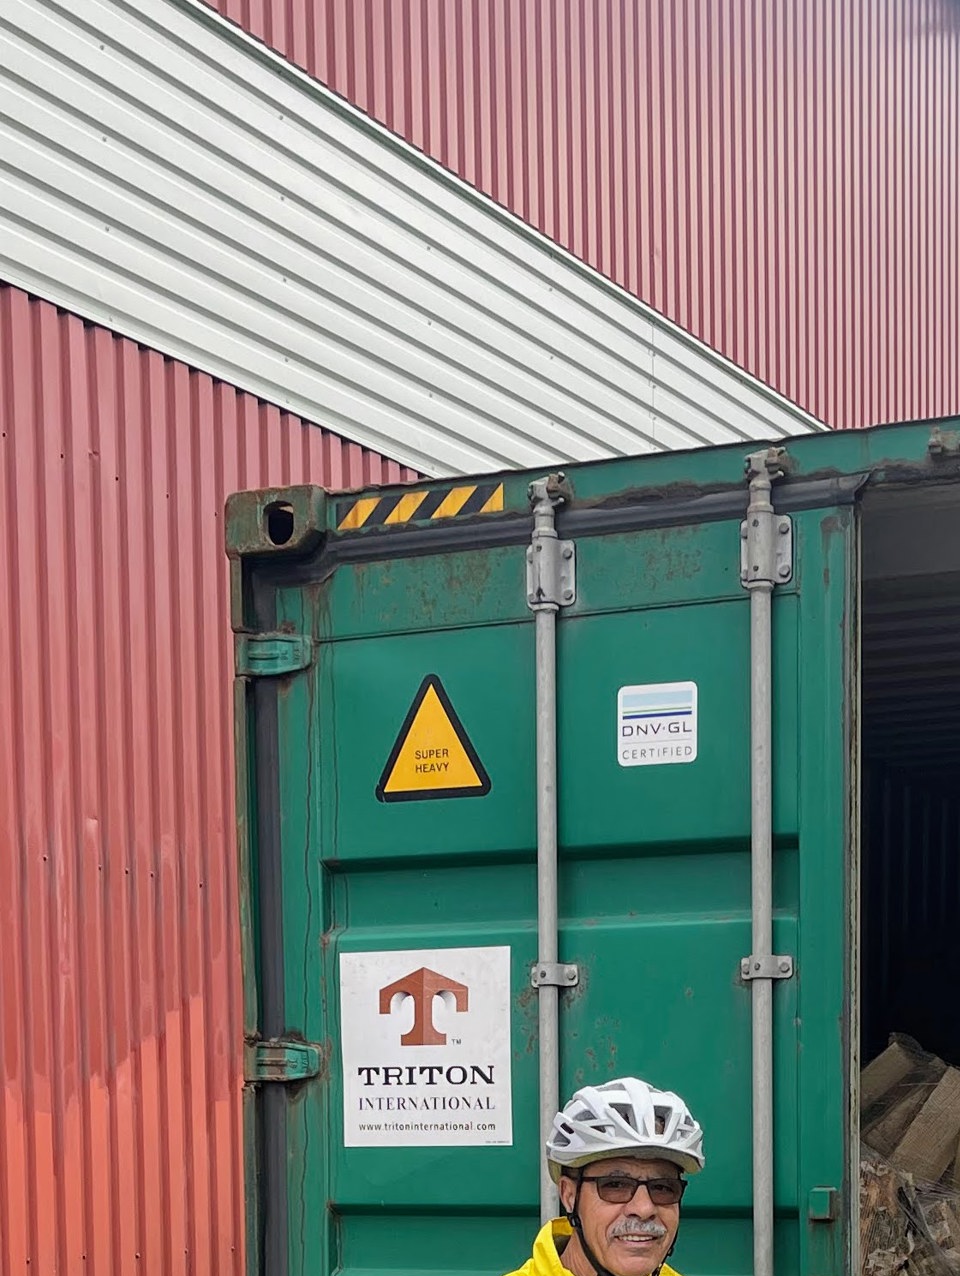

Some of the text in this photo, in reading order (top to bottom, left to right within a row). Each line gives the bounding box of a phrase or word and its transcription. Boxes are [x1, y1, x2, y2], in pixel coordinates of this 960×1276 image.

[414, 748, 449, 760] SUPER
[622, 745, 693, 760] CERTIFIED
[414, 762, 450, 774] HEAVY
[357, 1066, 495, 1086] TRITON
[358, 1096, 496, 1111] INTERNATIONAL
[358, 1121, 496, 1131] www.tritoninternational.com
